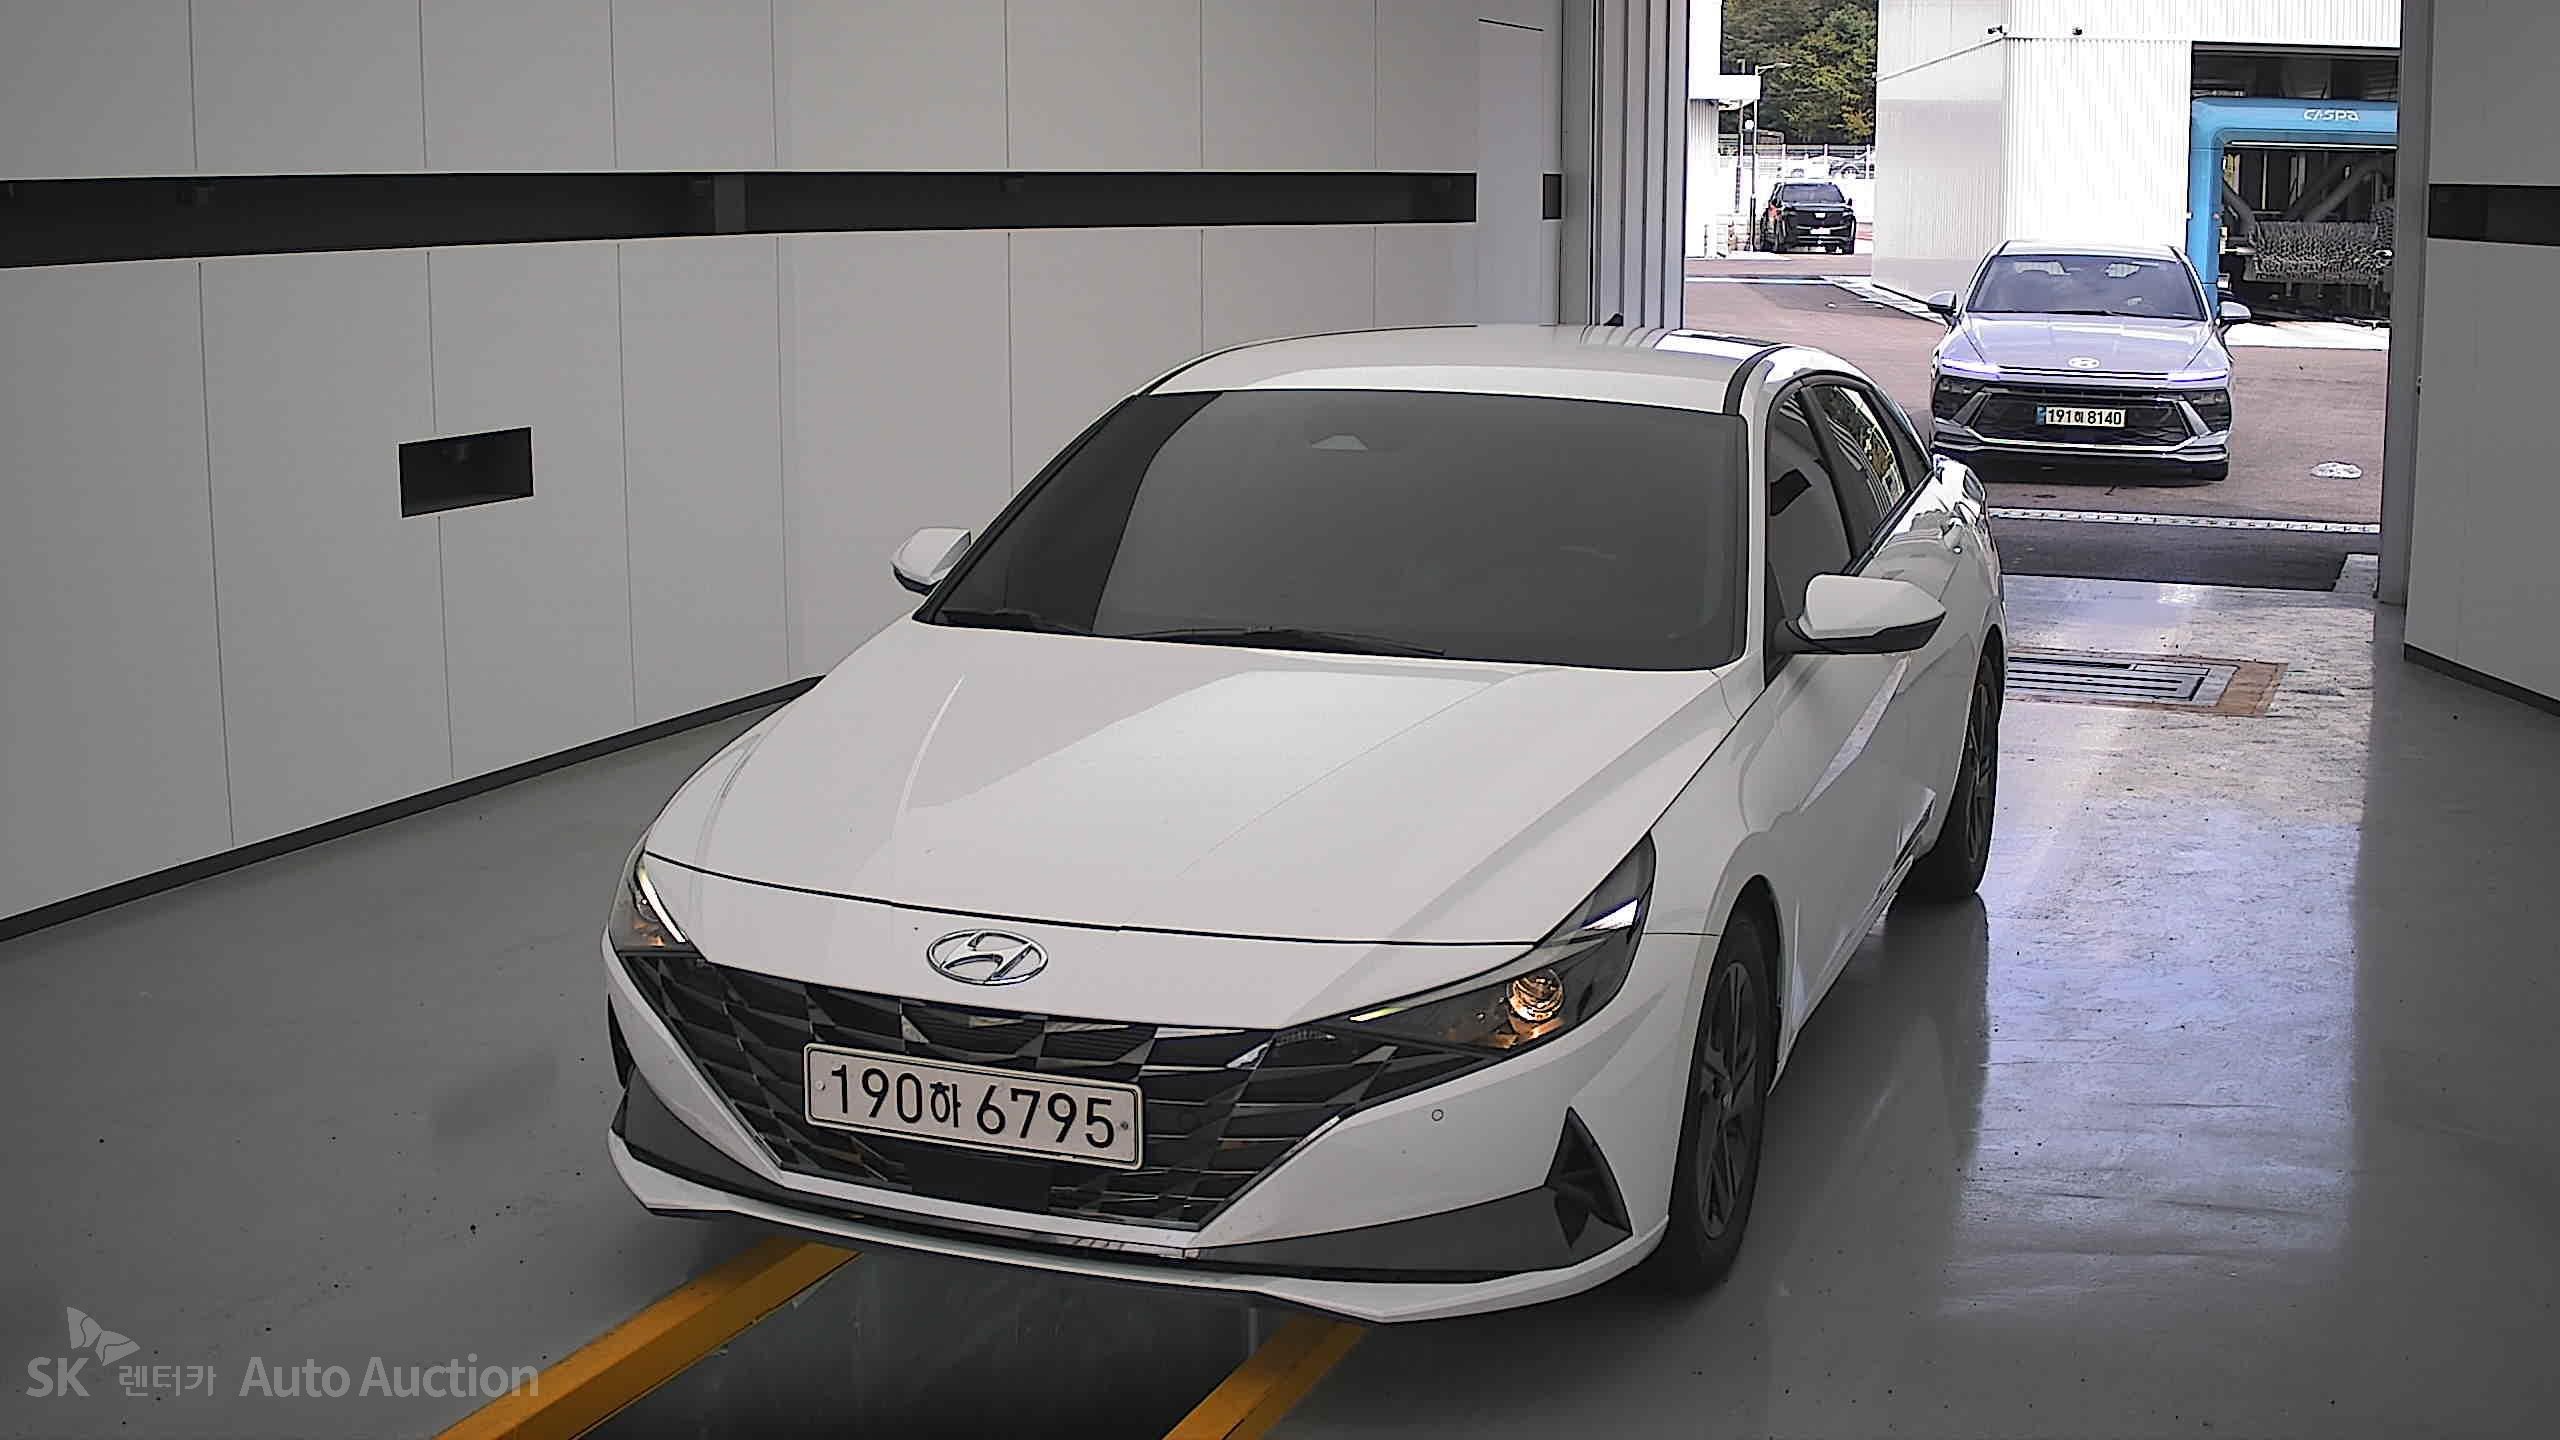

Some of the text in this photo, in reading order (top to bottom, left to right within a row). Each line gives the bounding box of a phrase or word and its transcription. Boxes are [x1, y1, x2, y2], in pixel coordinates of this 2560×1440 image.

[2087, 410, 2122, 425] 8140
[831, 1063, 1115, 1149] 190하 6795
